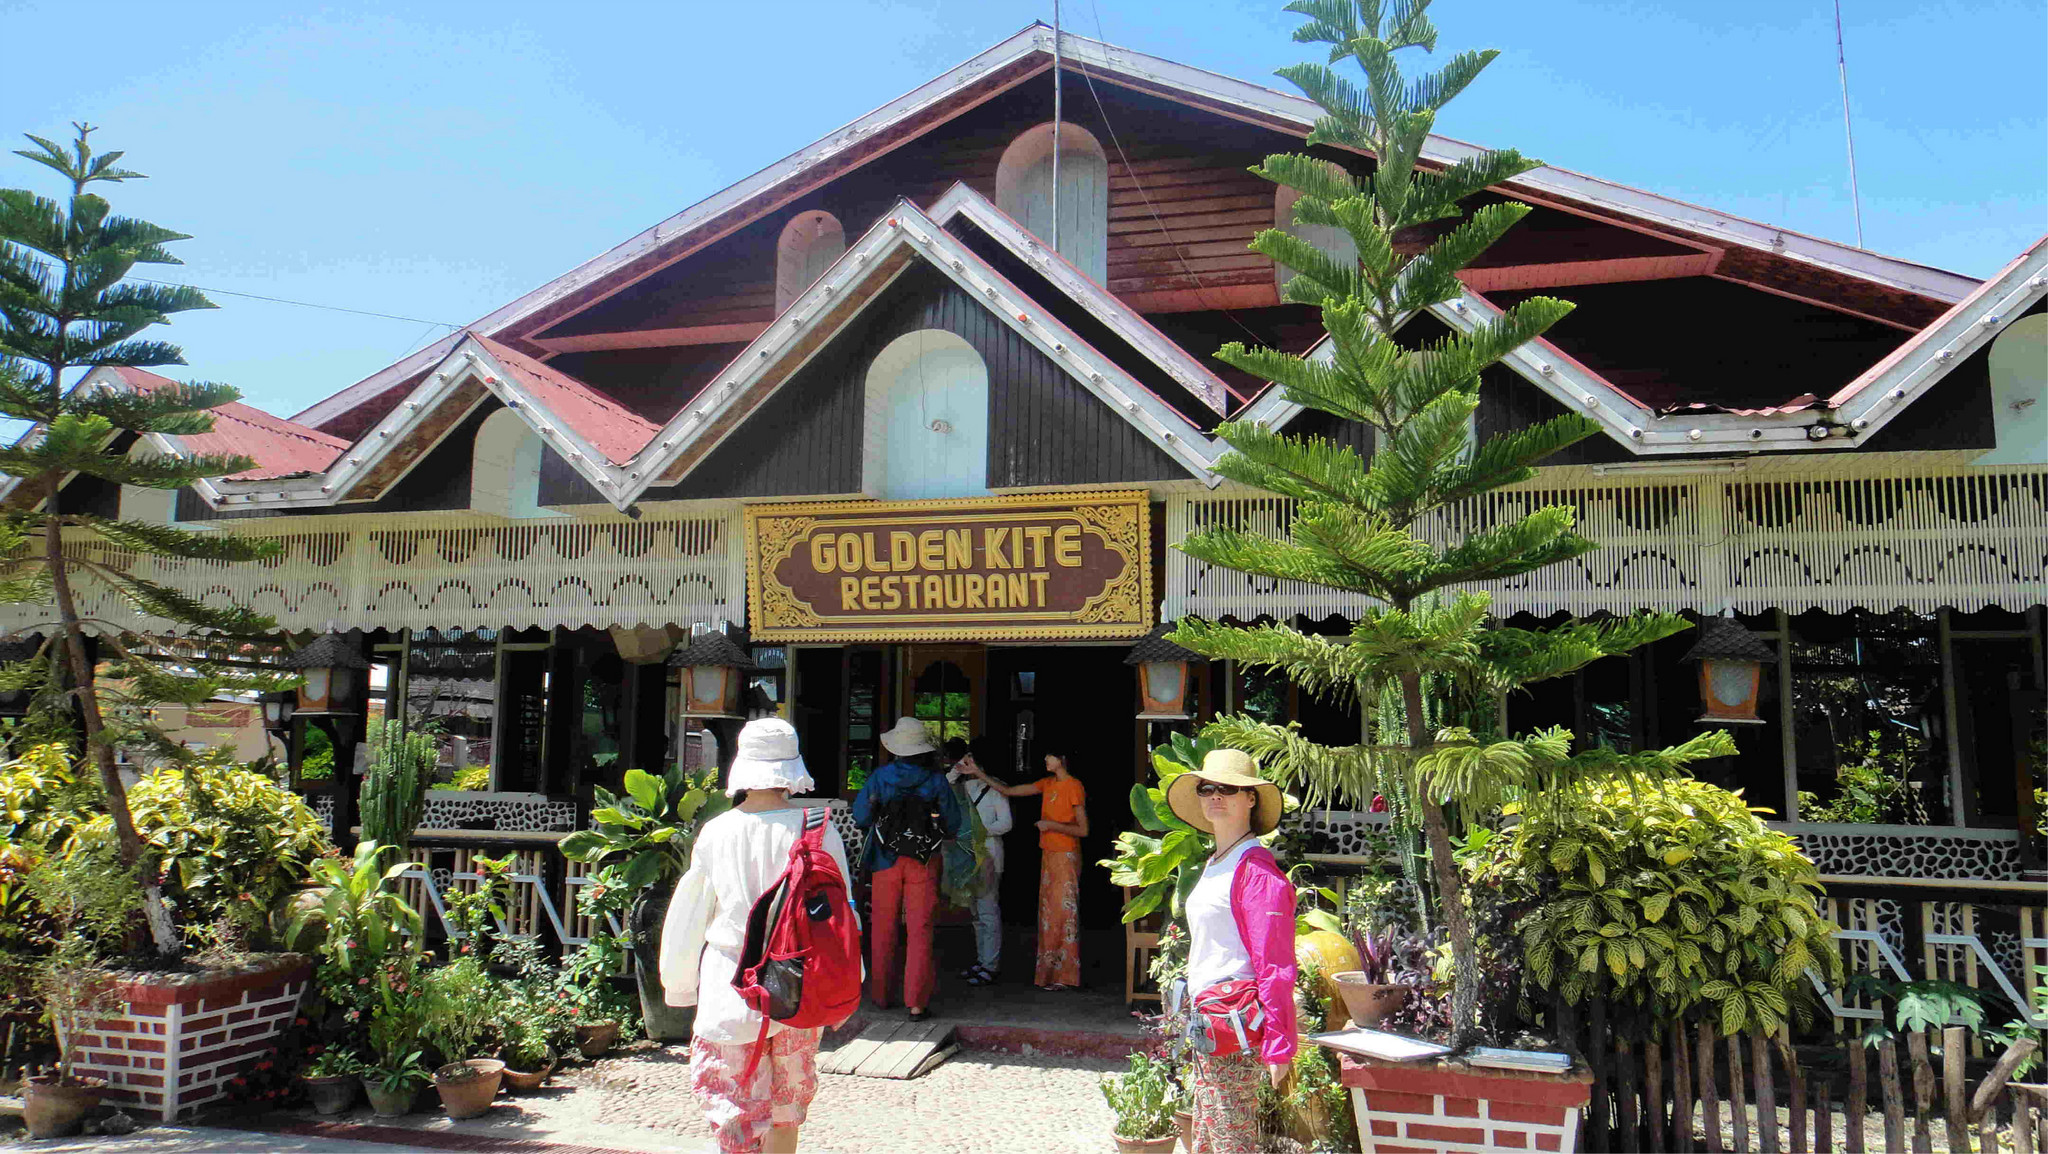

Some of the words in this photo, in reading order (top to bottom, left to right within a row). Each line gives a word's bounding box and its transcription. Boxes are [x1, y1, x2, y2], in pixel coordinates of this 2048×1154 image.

[811, 529, 972, 573] GOLDEN
[985, 525, 1082, 569] KITE
[841, 572, 1050, 610] RESTAURANT
